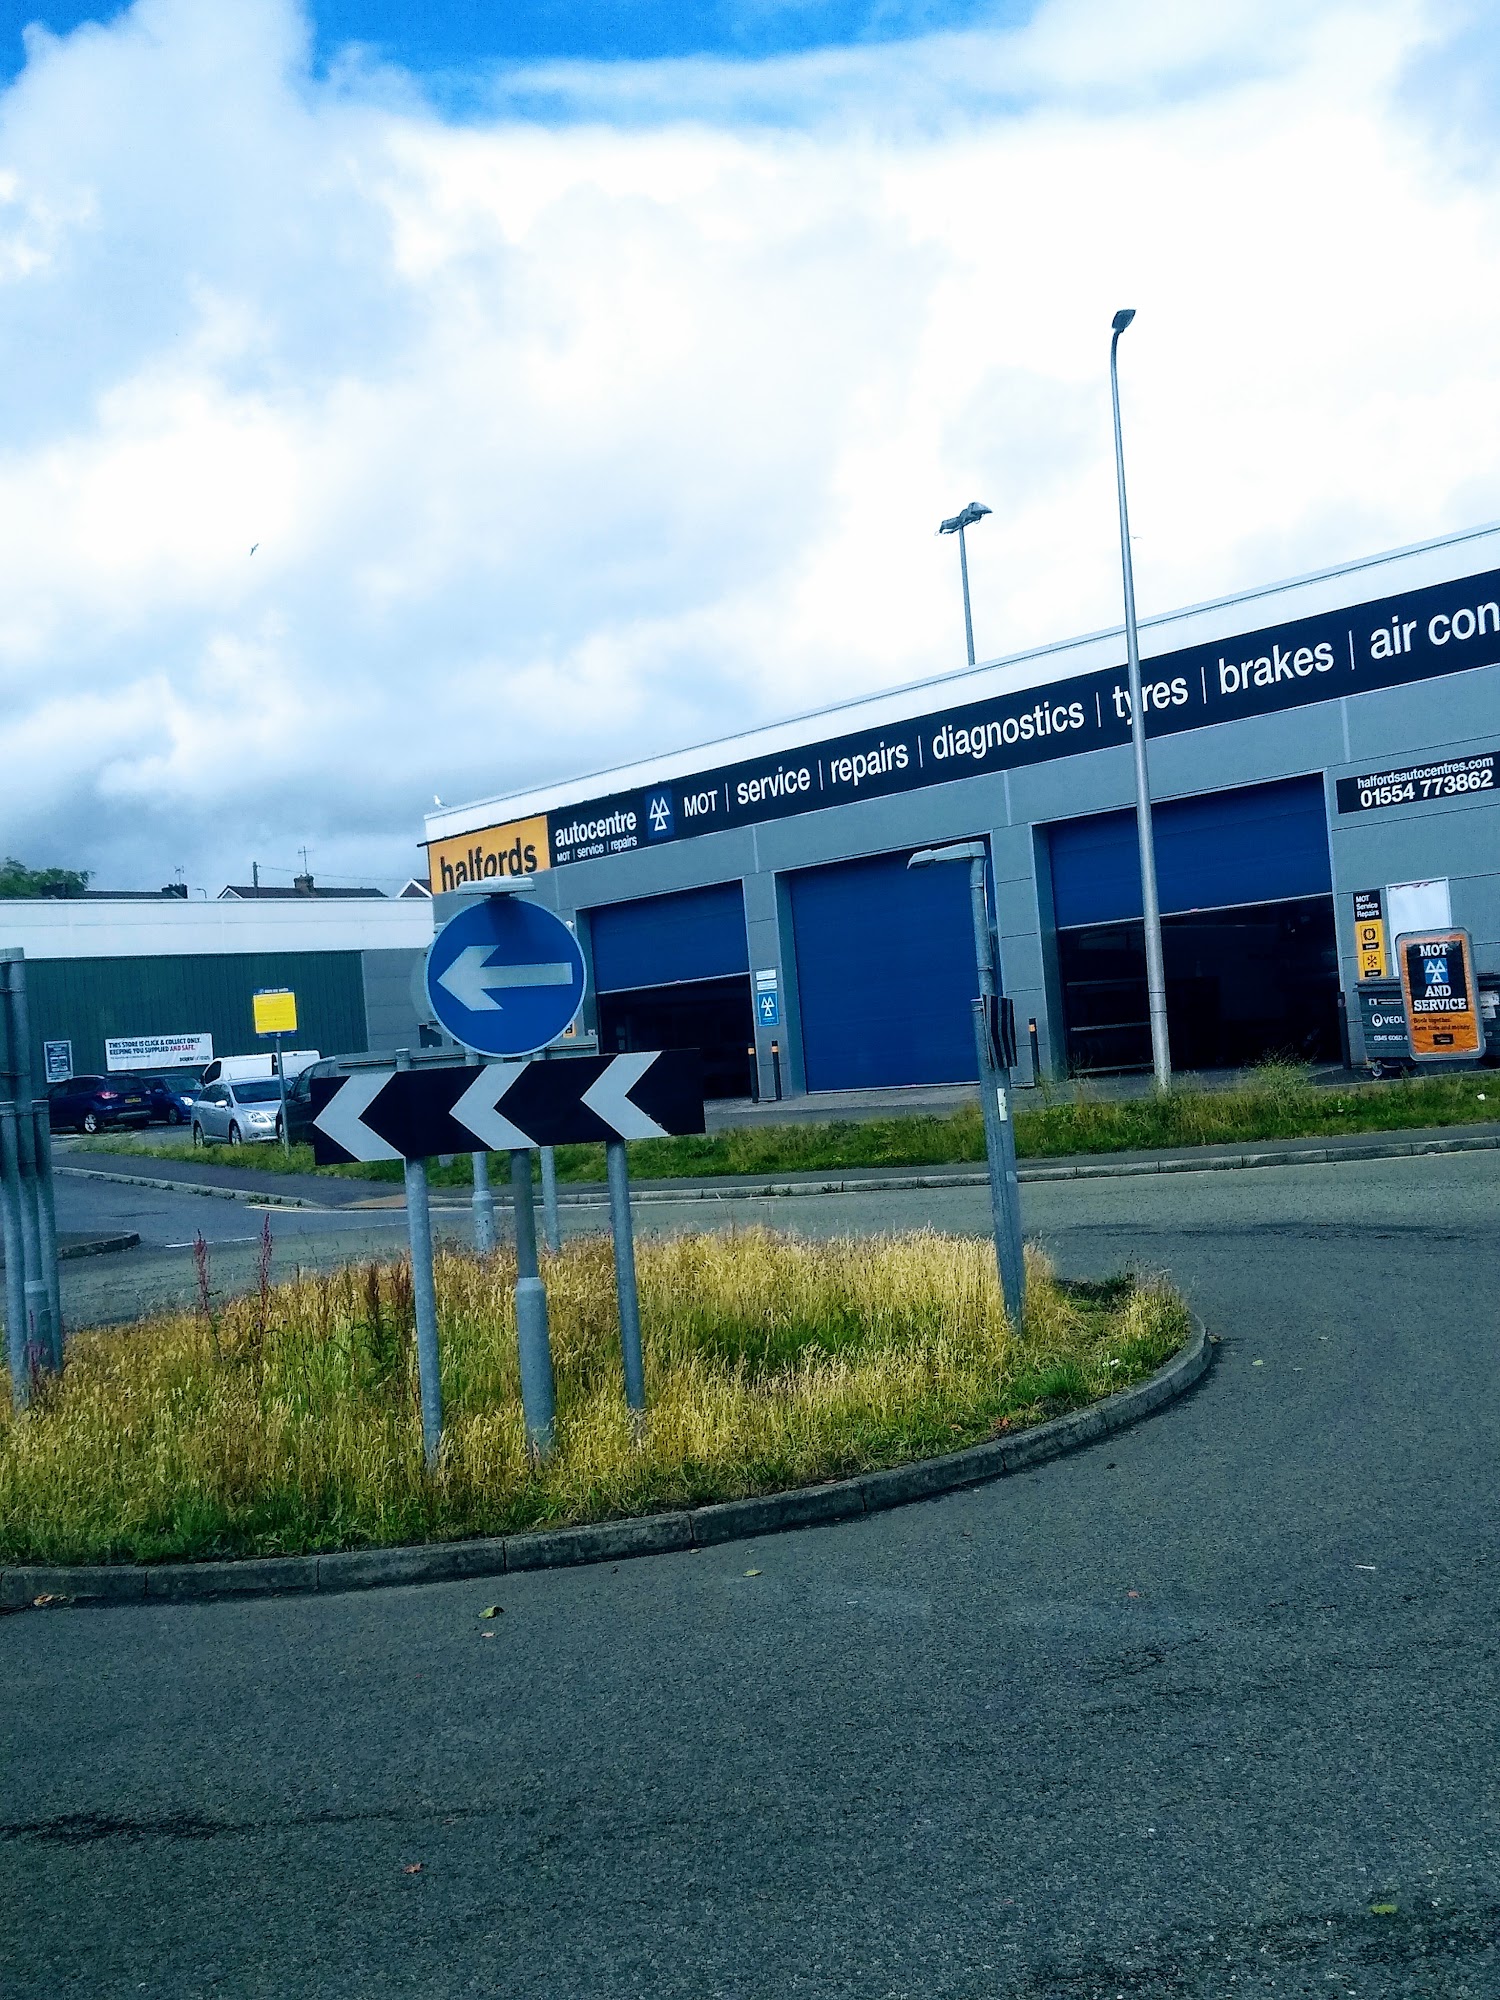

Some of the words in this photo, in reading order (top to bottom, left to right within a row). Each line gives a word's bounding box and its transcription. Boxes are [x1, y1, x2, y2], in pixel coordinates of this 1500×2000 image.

[683, 790, 718, 817] MOT
[737, 766, 811, 804] service
[830, 741, 909, 786] repairs
[932, 701, 1085, 759] diagnostics
[1218, 641, 1334, 694] brakes
[1370, 615, 1417, 660] air
[1428, 602, 1500, 645] con
[1357, 757, 1494, 789] halfordsautocentres.com
[1360, 782, 1415, 808] 01554
[1420, 769, 1494, 798] 773862
[555, 810, 637, 848] autocentre
[557, 851, 571, 863] MOT
[577, 843, 604, 859] service
[610, 835, 638, 852] repairs
[440, 837, 538, 892] halfords
[1356, 895, 1370, 903] MOT
[1356, 902, 1379, 911] Service
[1357, 909, 1380, 919] Repairs
[1419, 943, 1448, 957] MOT
[1425, 985, 1452, 998] AND
[1413, 998, 1467, 1012] SERVICE
[144, 1045, 169, 1053] SUPPLIED
